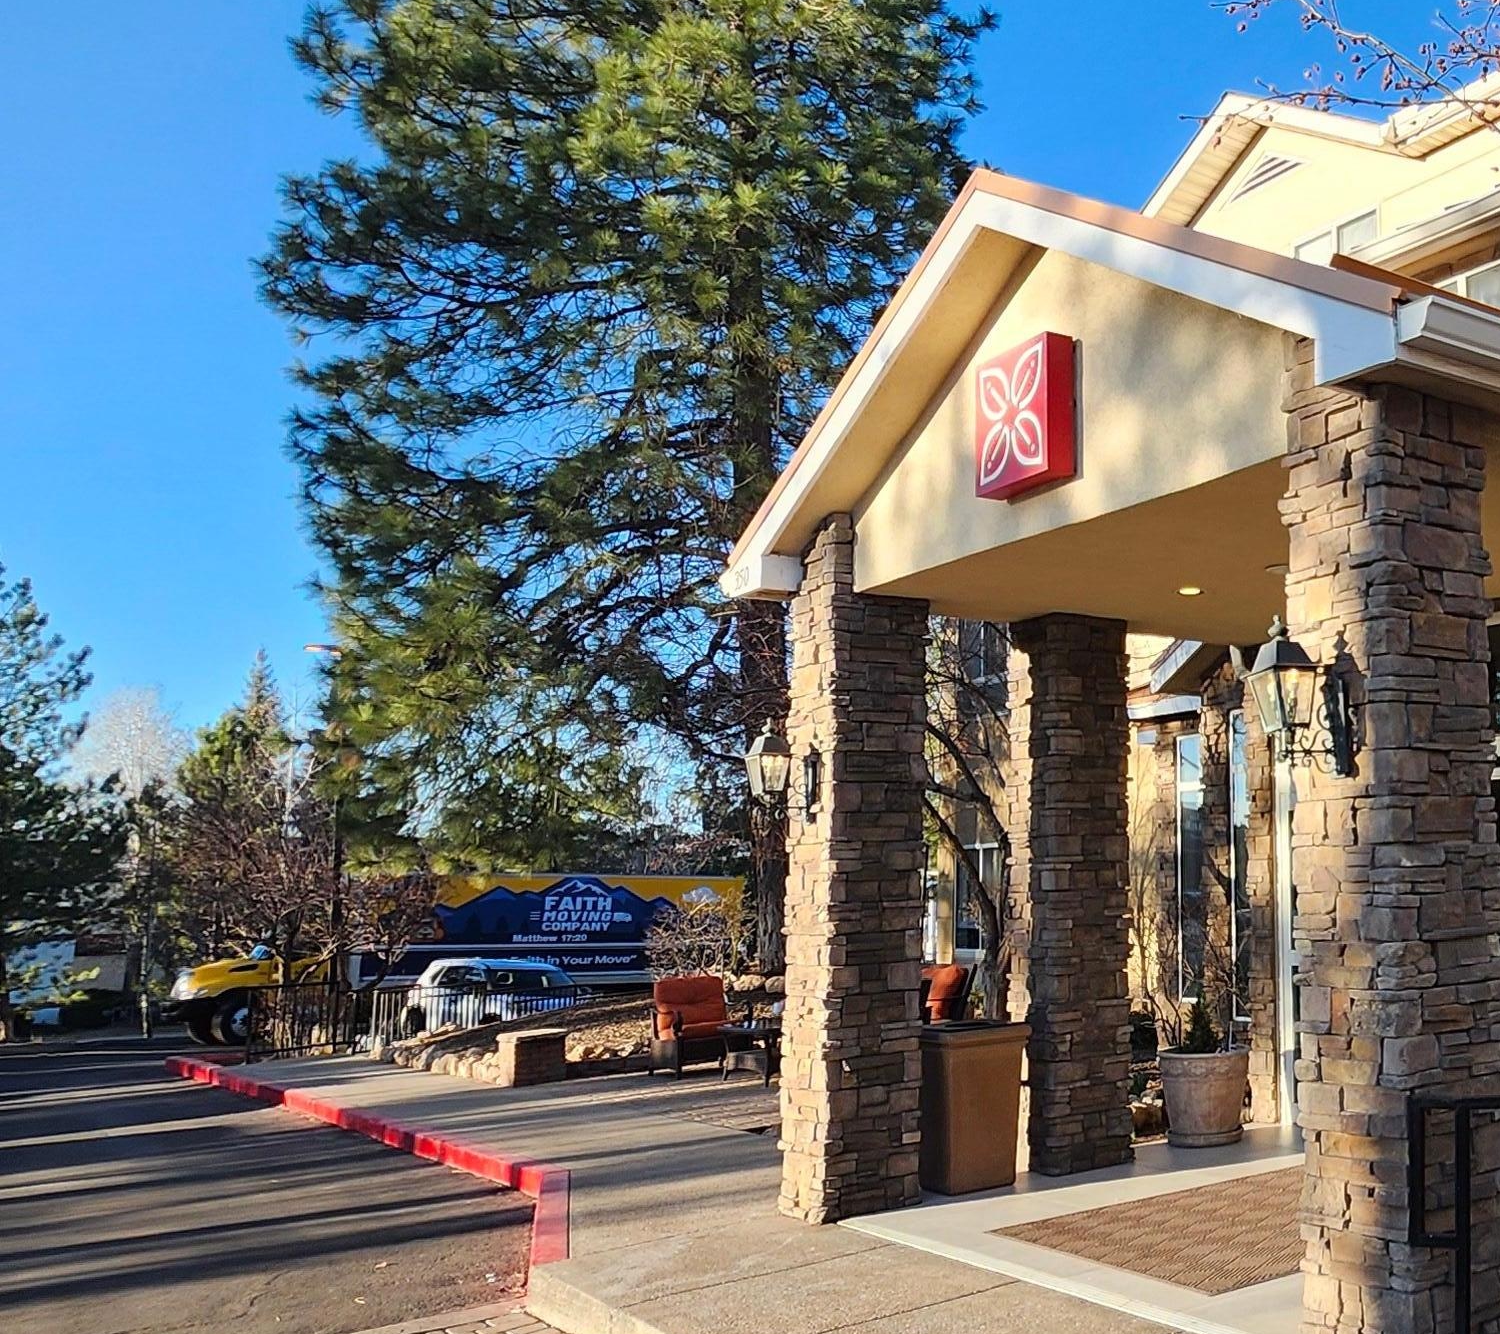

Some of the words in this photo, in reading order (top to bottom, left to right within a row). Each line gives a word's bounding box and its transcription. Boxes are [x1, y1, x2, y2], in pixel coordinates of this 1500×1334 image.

[544, 896, 613, 911] FAITH
[542, 911, 613, 922] MOVING
[541, 922, 611, 932] COMPANY
[512, 934, 558, 942] Matthew
[561, 934, 588, 942] 17:20
[547, 955, 560, 965] in
[561, 956, 592, 965] Your
